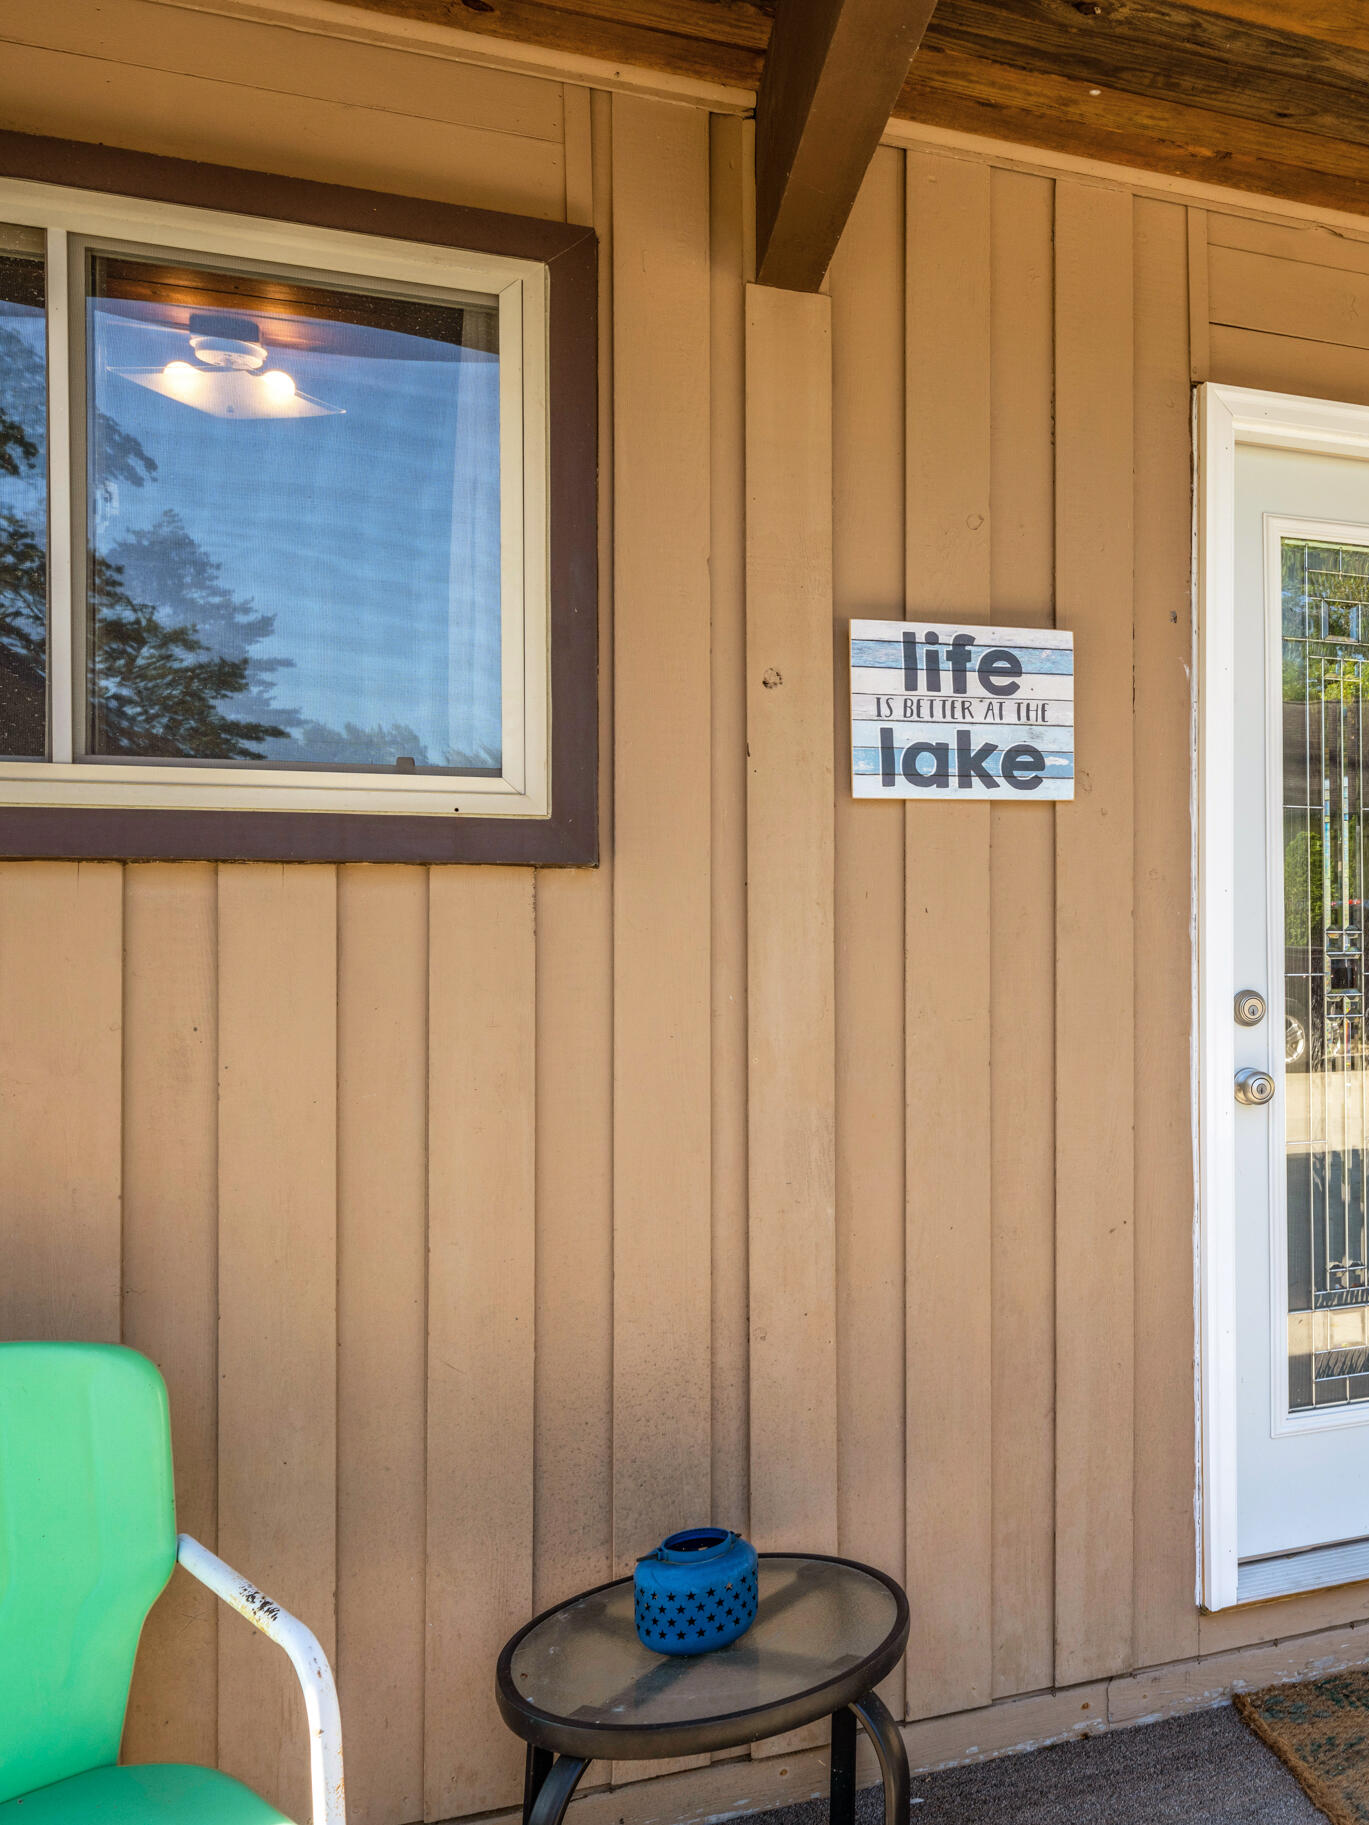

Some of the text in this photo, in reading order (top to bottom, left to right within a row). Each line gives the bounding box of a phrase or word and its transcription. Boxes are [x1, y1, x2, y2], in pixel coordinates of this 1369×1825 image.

[902, 631, 1022, 697] life
[875, 697, 1050, 723] IS BETTER AT THE
[880, 727, 1046, 791] lake
